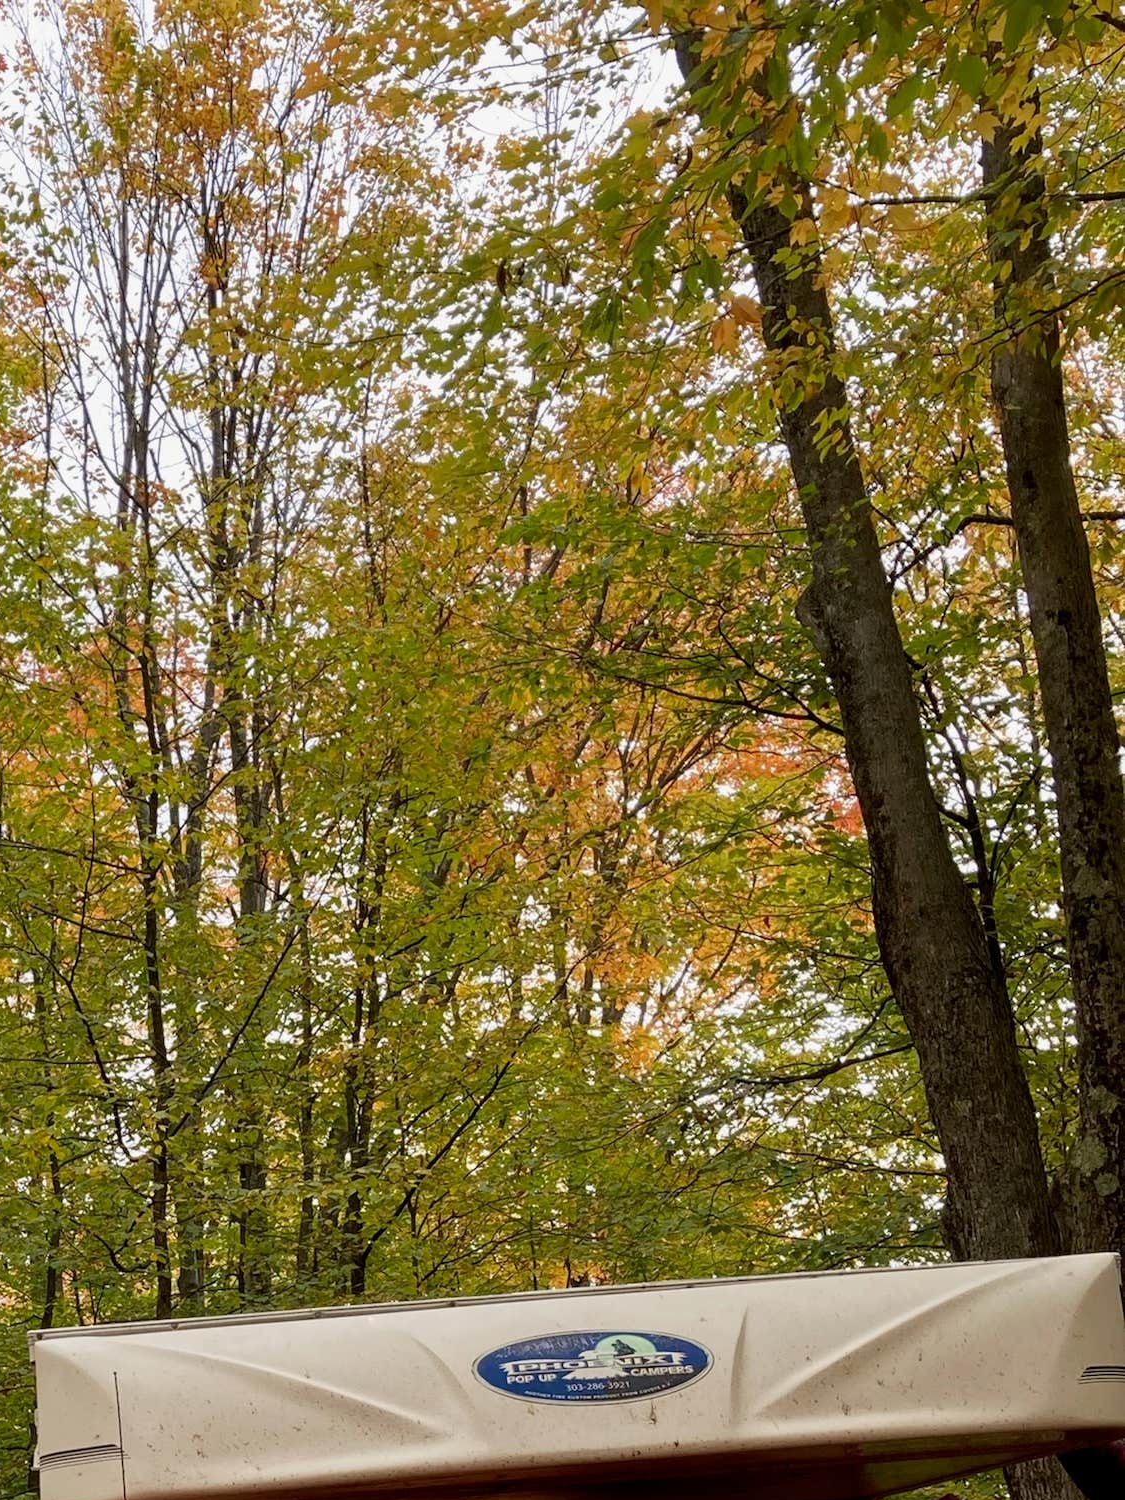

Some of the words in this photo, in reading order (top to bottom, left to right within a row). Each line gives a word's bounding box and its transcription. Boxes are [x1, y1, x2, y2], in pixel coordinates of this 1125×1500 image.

[506, 1375, 535, 1384] POP
[538, 1374, 557, 1382] UP
[630, 1365, 694, 1376] CAMPERS
[565, 1382, 630, 1391] 303-286-3921
